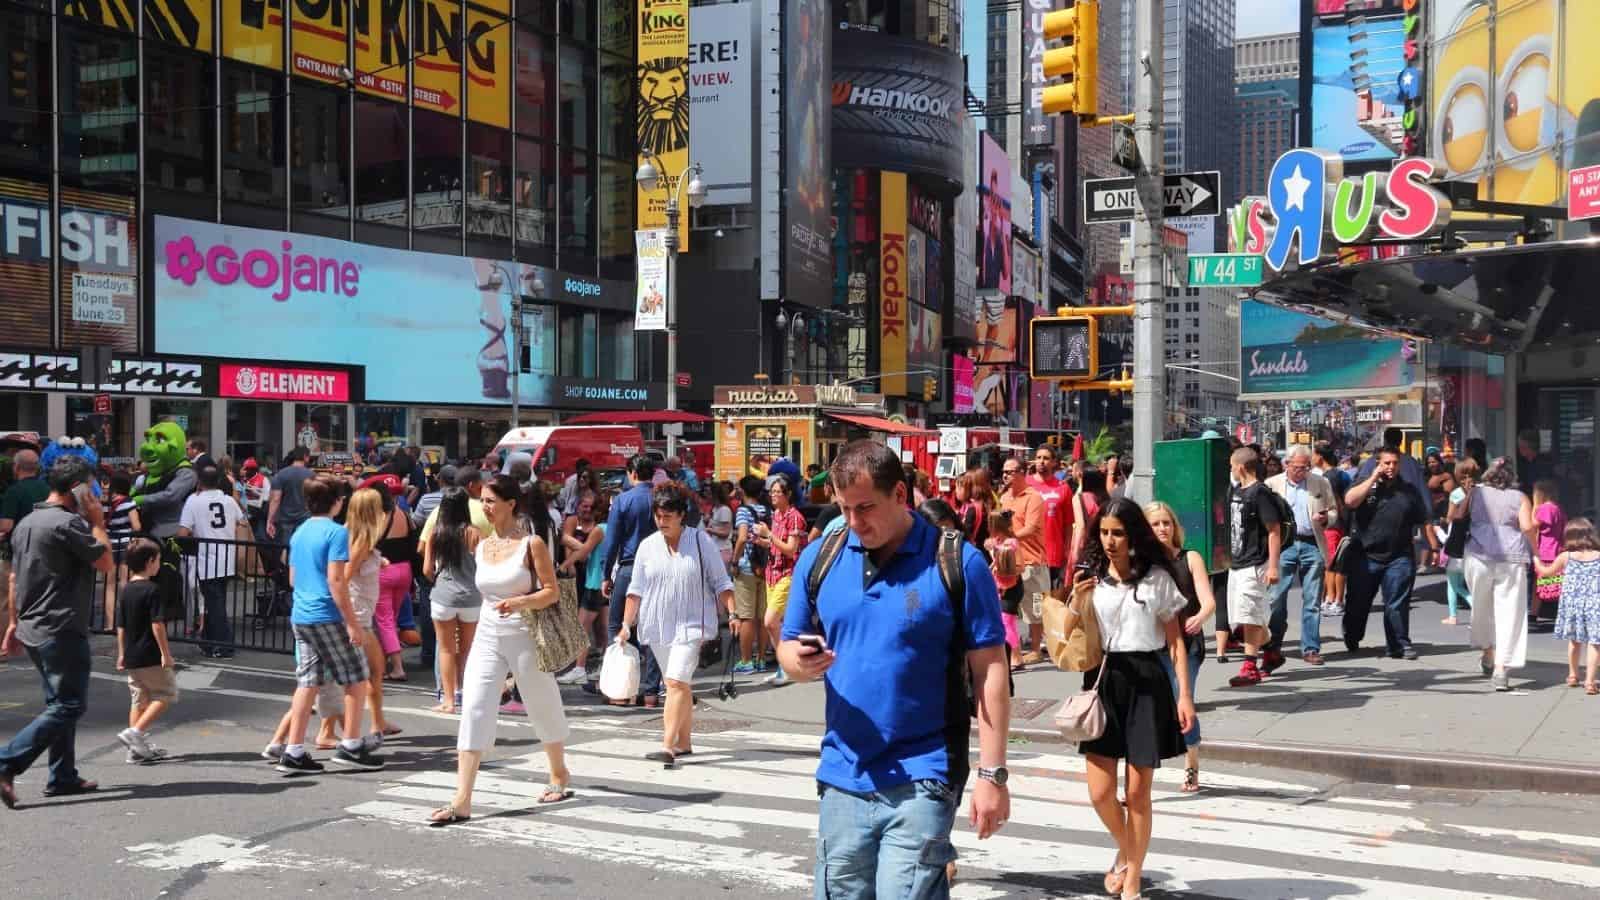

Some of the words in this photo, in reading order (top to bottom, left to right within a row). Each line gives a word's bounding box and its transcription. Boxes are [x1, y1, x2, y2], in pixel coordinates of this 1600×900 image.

[642, 11, 684, 34] KING
[688, 40, 738, 64] ERE!
[692, 72, 732, 86] VIEW.
[380, 79, 402, 95] 45TH
[413, 88, 441, 105] STREET
[690, 95, 719, 104] aurant
[1573, 174, 1584, 185] NO
[1331, 158, 1438, 243] US
[0, 202, 129, 266] FISH
[1194, 257, 1208, 283] W
[1214, 257, 1236, 282] 44
[1243, 256, 1256, 271] ST
[75, 276, 129, 292] Tuesdays
[882, 233, 904, 338] Kodak
[76, 306, 104, 320] June
[1248, 350, 1309, 377] Sandals
[260, 372, 335, 396] ELEMENT
[564, 385, 582, 397] SHOP
[585, 387, 648, 401] GOJANE.COM
[728, 386, 799, 404] nuchas
[209, 502, 226, 529] 3
